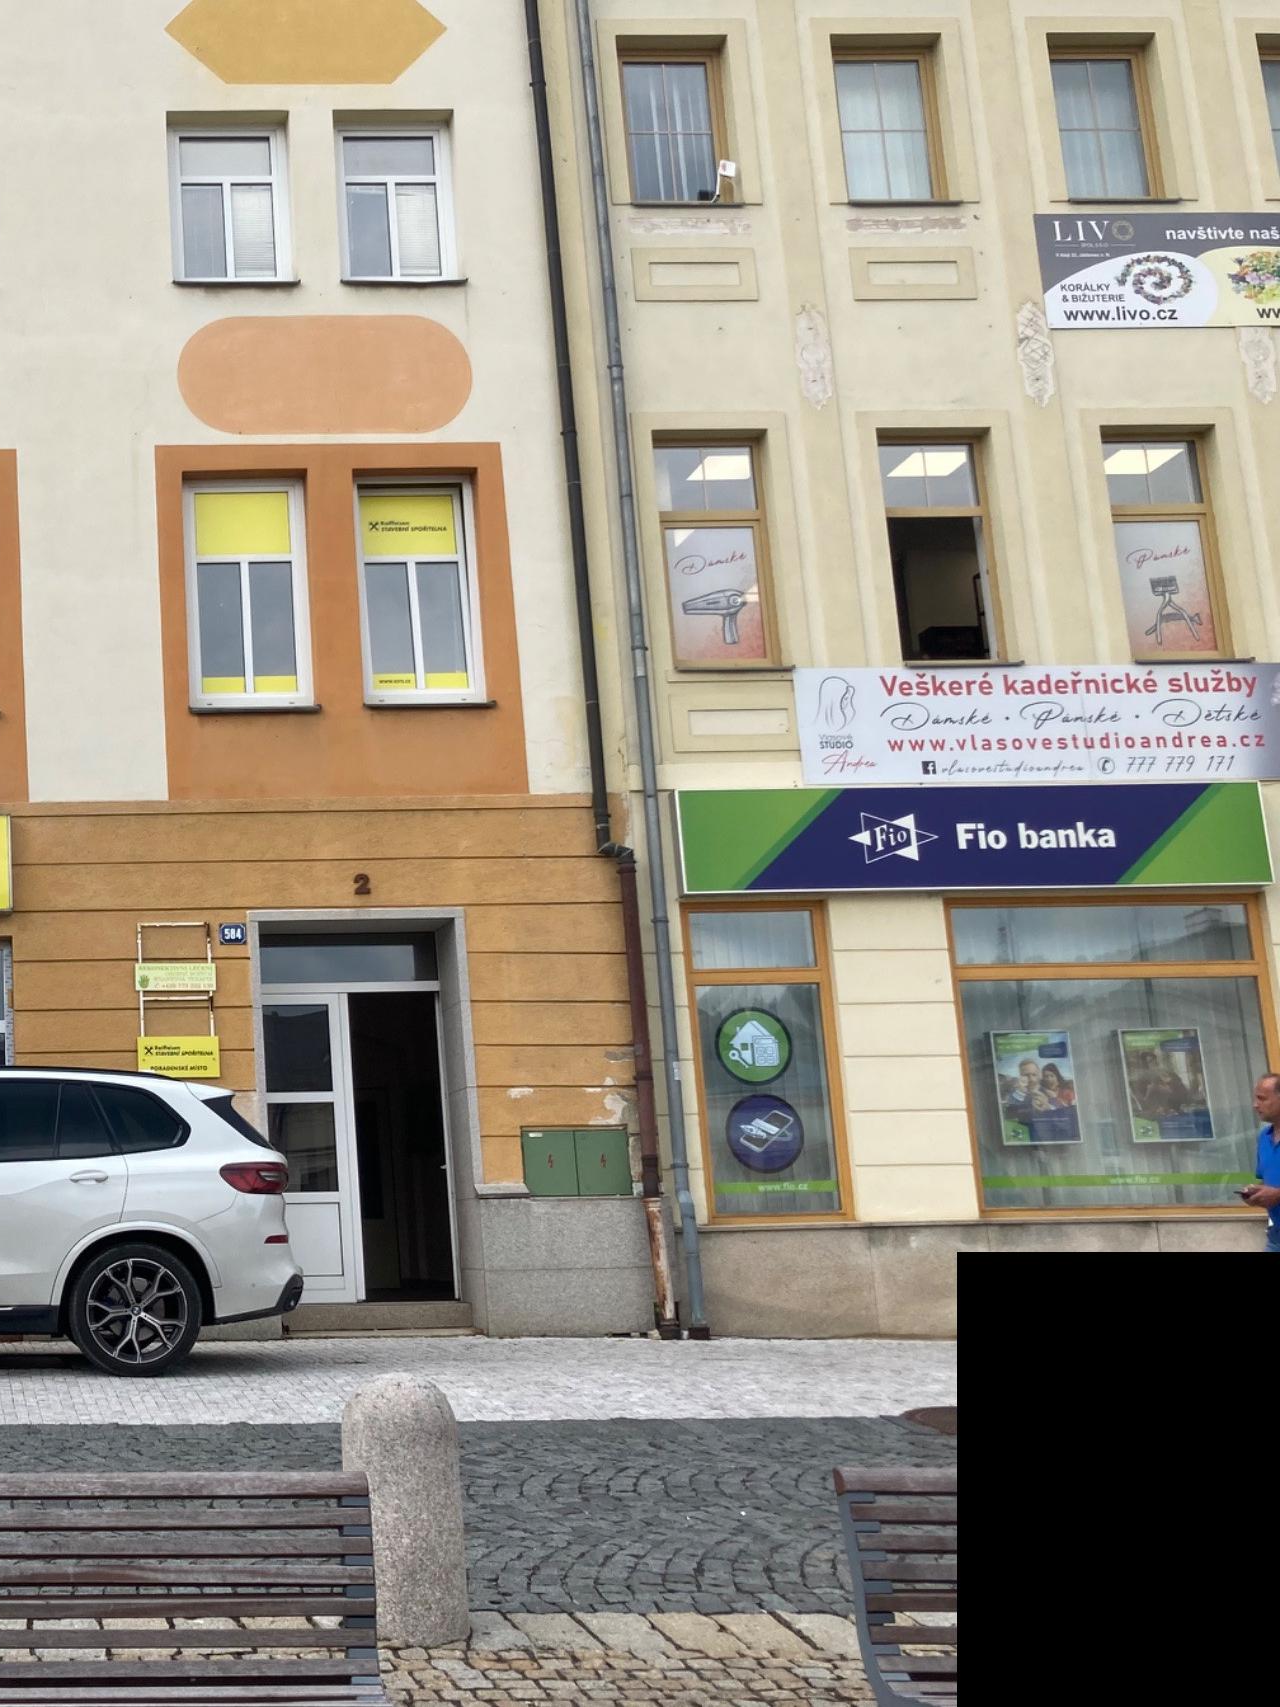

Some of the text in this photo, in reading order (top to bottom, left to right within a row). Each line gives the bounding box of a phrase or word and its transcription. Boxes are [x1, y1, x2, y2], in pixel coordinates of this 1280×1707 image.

[1166, 226, 1244, 240] navštivte
[1060, 282, 1110, 292] KORÁLKY
[1061, 292, 1125, 303] & BIŽUTERIE
[1064, 306, 1178, 321] www.livo.cz
[879, 669, 1257, 698] Veškeré kadeřnické služby
[880, 701, 992, 731] Dámské
[1019, 701, 1121, 730] Pánské
[819, 740, 854, 749] STUDIO
[887, 731, 1266, 752] www.vlasovestudioandrea.cz
[1126, 755, 1235, 773] 777 779 171
[874, 824, 908, 852] Fio
[955, 821, 1117, 850] Fio banka
[353, 873, 371, 895] 2
[224, 928, 242, 940] 584
